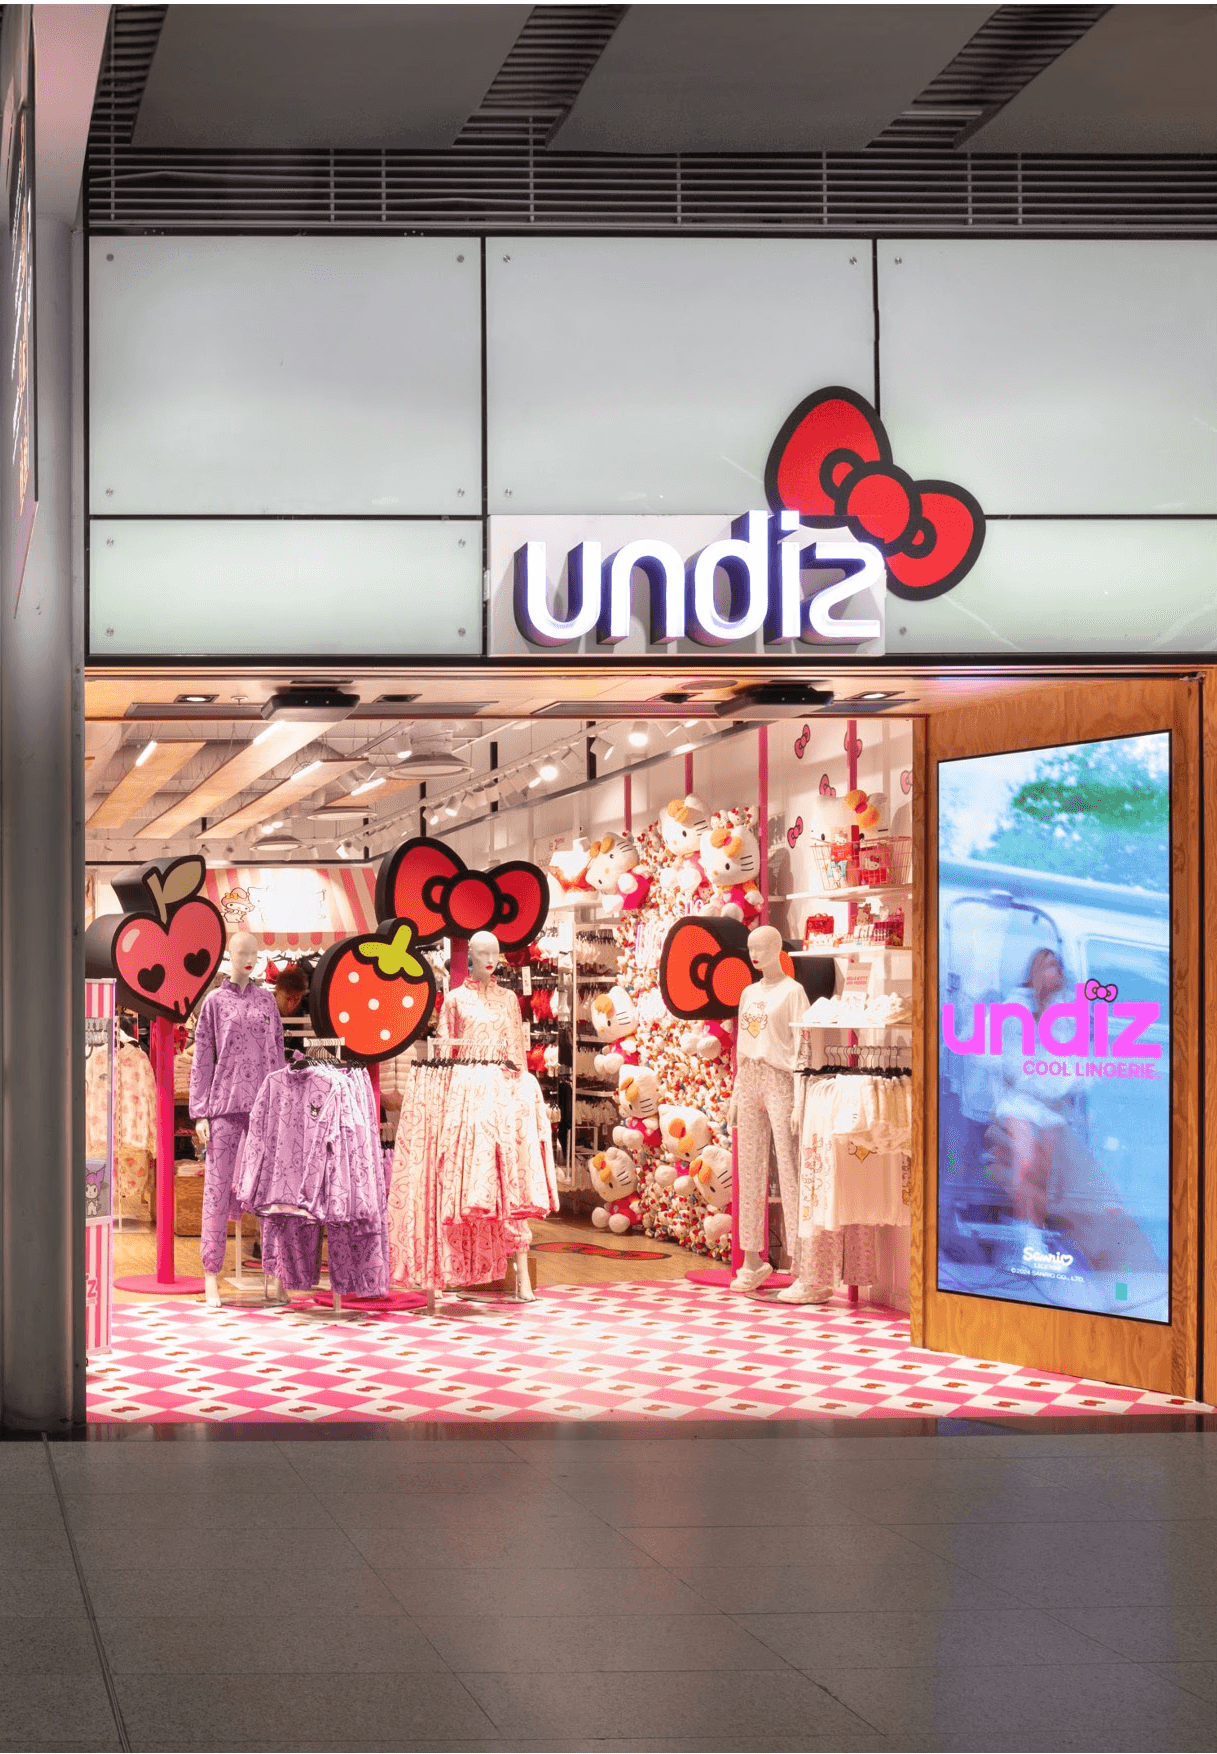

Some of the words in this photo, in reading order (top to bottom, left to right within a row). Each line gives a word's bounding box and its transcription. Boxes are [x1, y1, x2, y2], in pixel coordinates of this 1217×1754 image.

[514, 510, 886, 646] undiz
[942, 982, 1163, 1059] undiz
[1023, 1060, 1071, 1077] COOL
